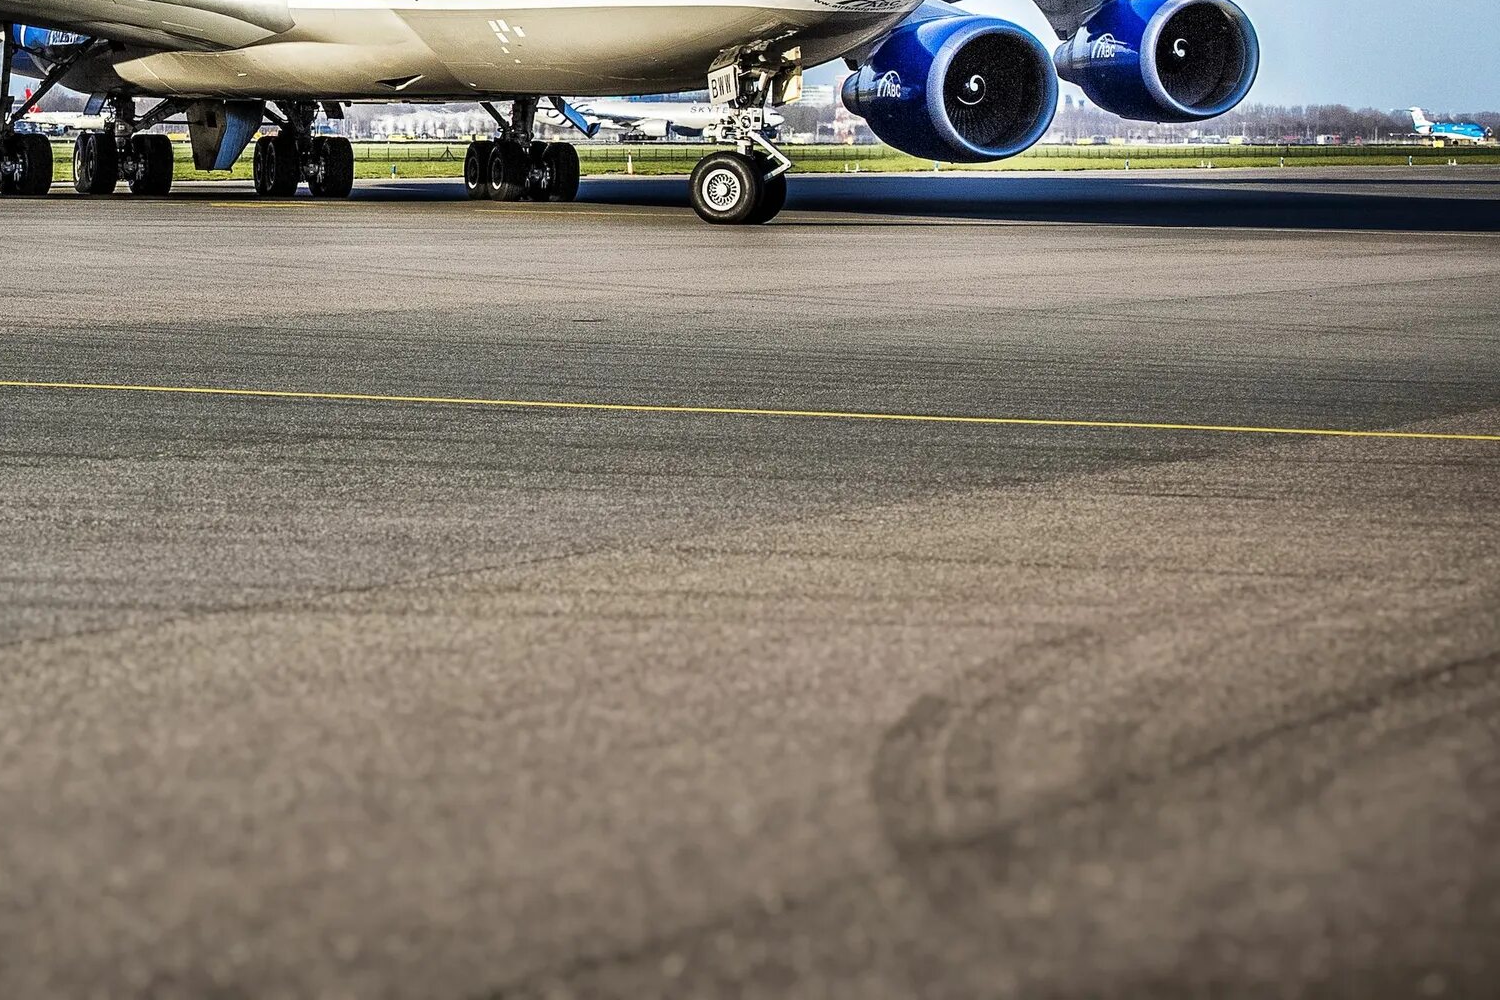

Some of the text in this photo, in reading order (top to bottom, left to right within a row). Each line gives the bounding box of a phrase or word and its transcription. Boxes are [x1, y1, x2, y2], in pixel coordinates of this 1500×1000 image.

[711, 73, 732, 99] BWW
[886, 83, 901, 98] ABC
[690, 106, 729, 114] SKYTE
